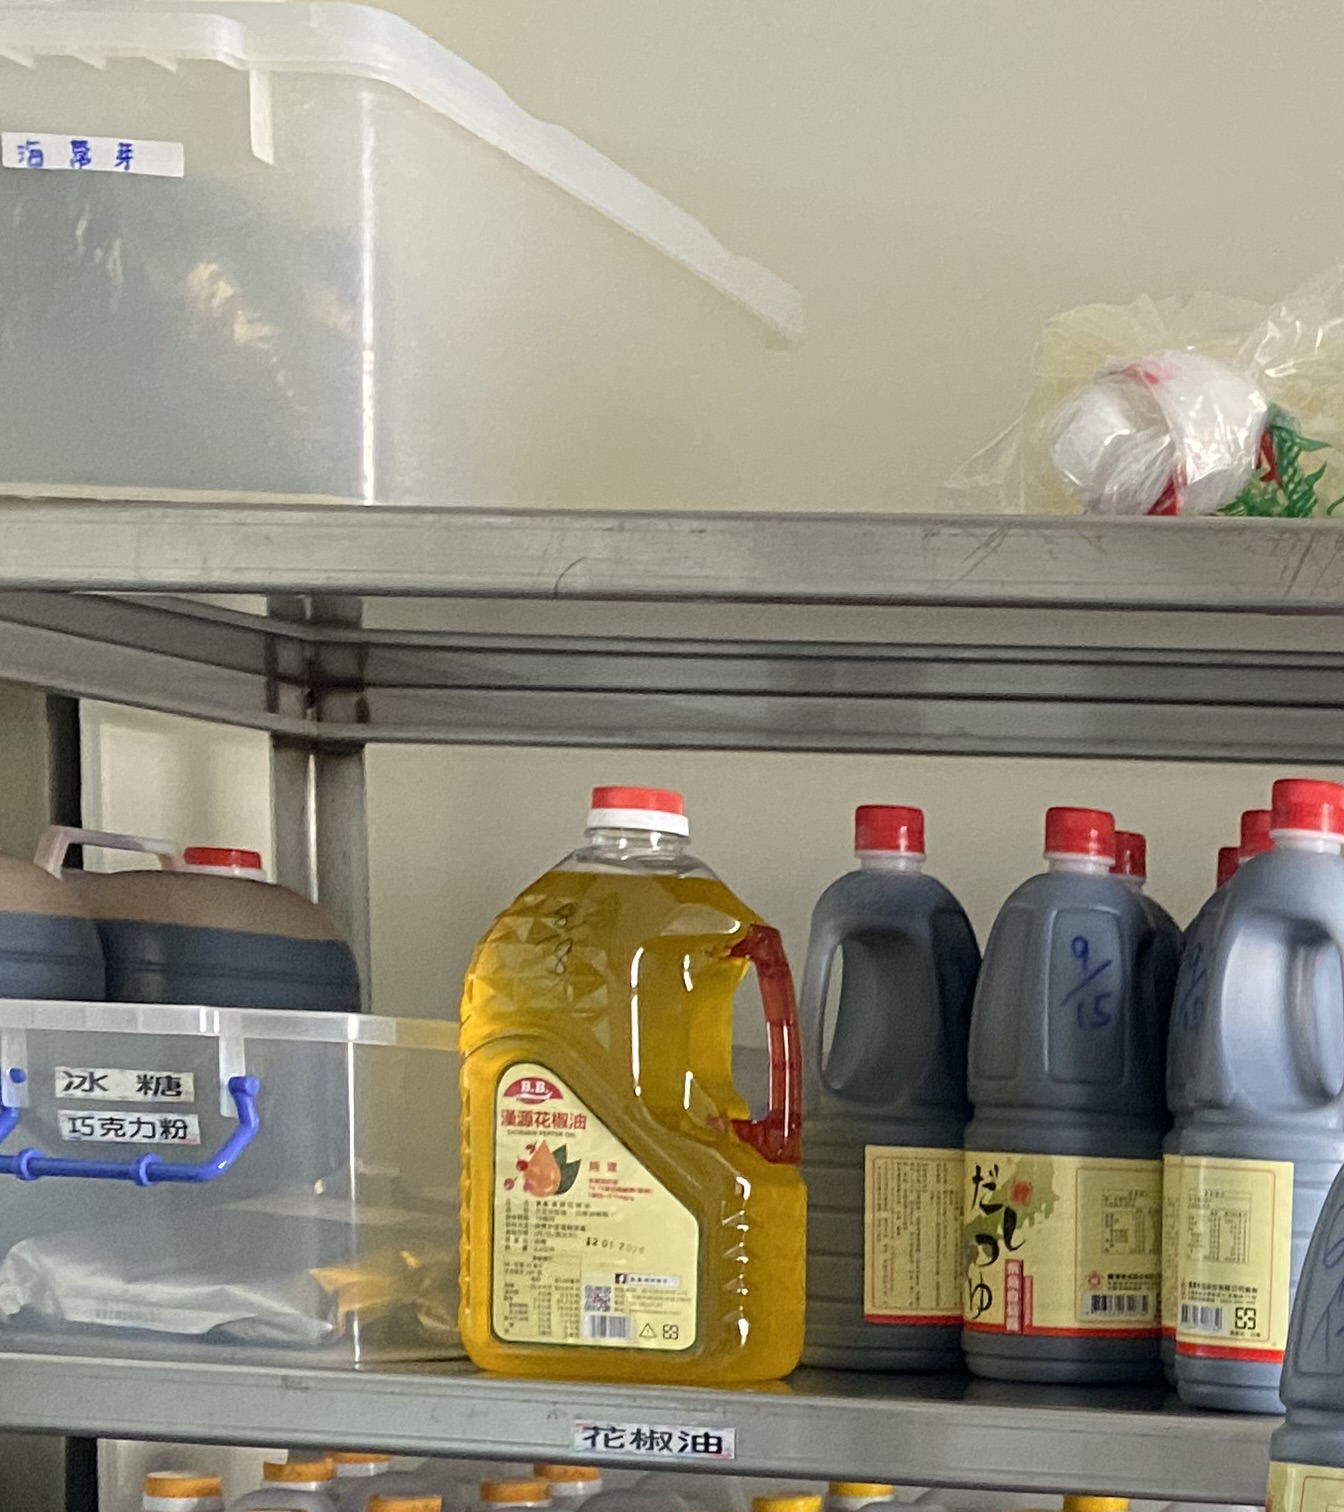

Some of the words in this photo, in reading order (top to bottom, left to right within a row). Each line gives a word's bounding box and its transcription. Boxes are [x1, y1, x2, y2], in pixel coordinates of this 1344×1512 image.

[61, 1070, 184, 1097] 冰糖
[66, 1116, 189, 1142] 巧克力粉
[582, 1425, 723, 1455] 花椒油
